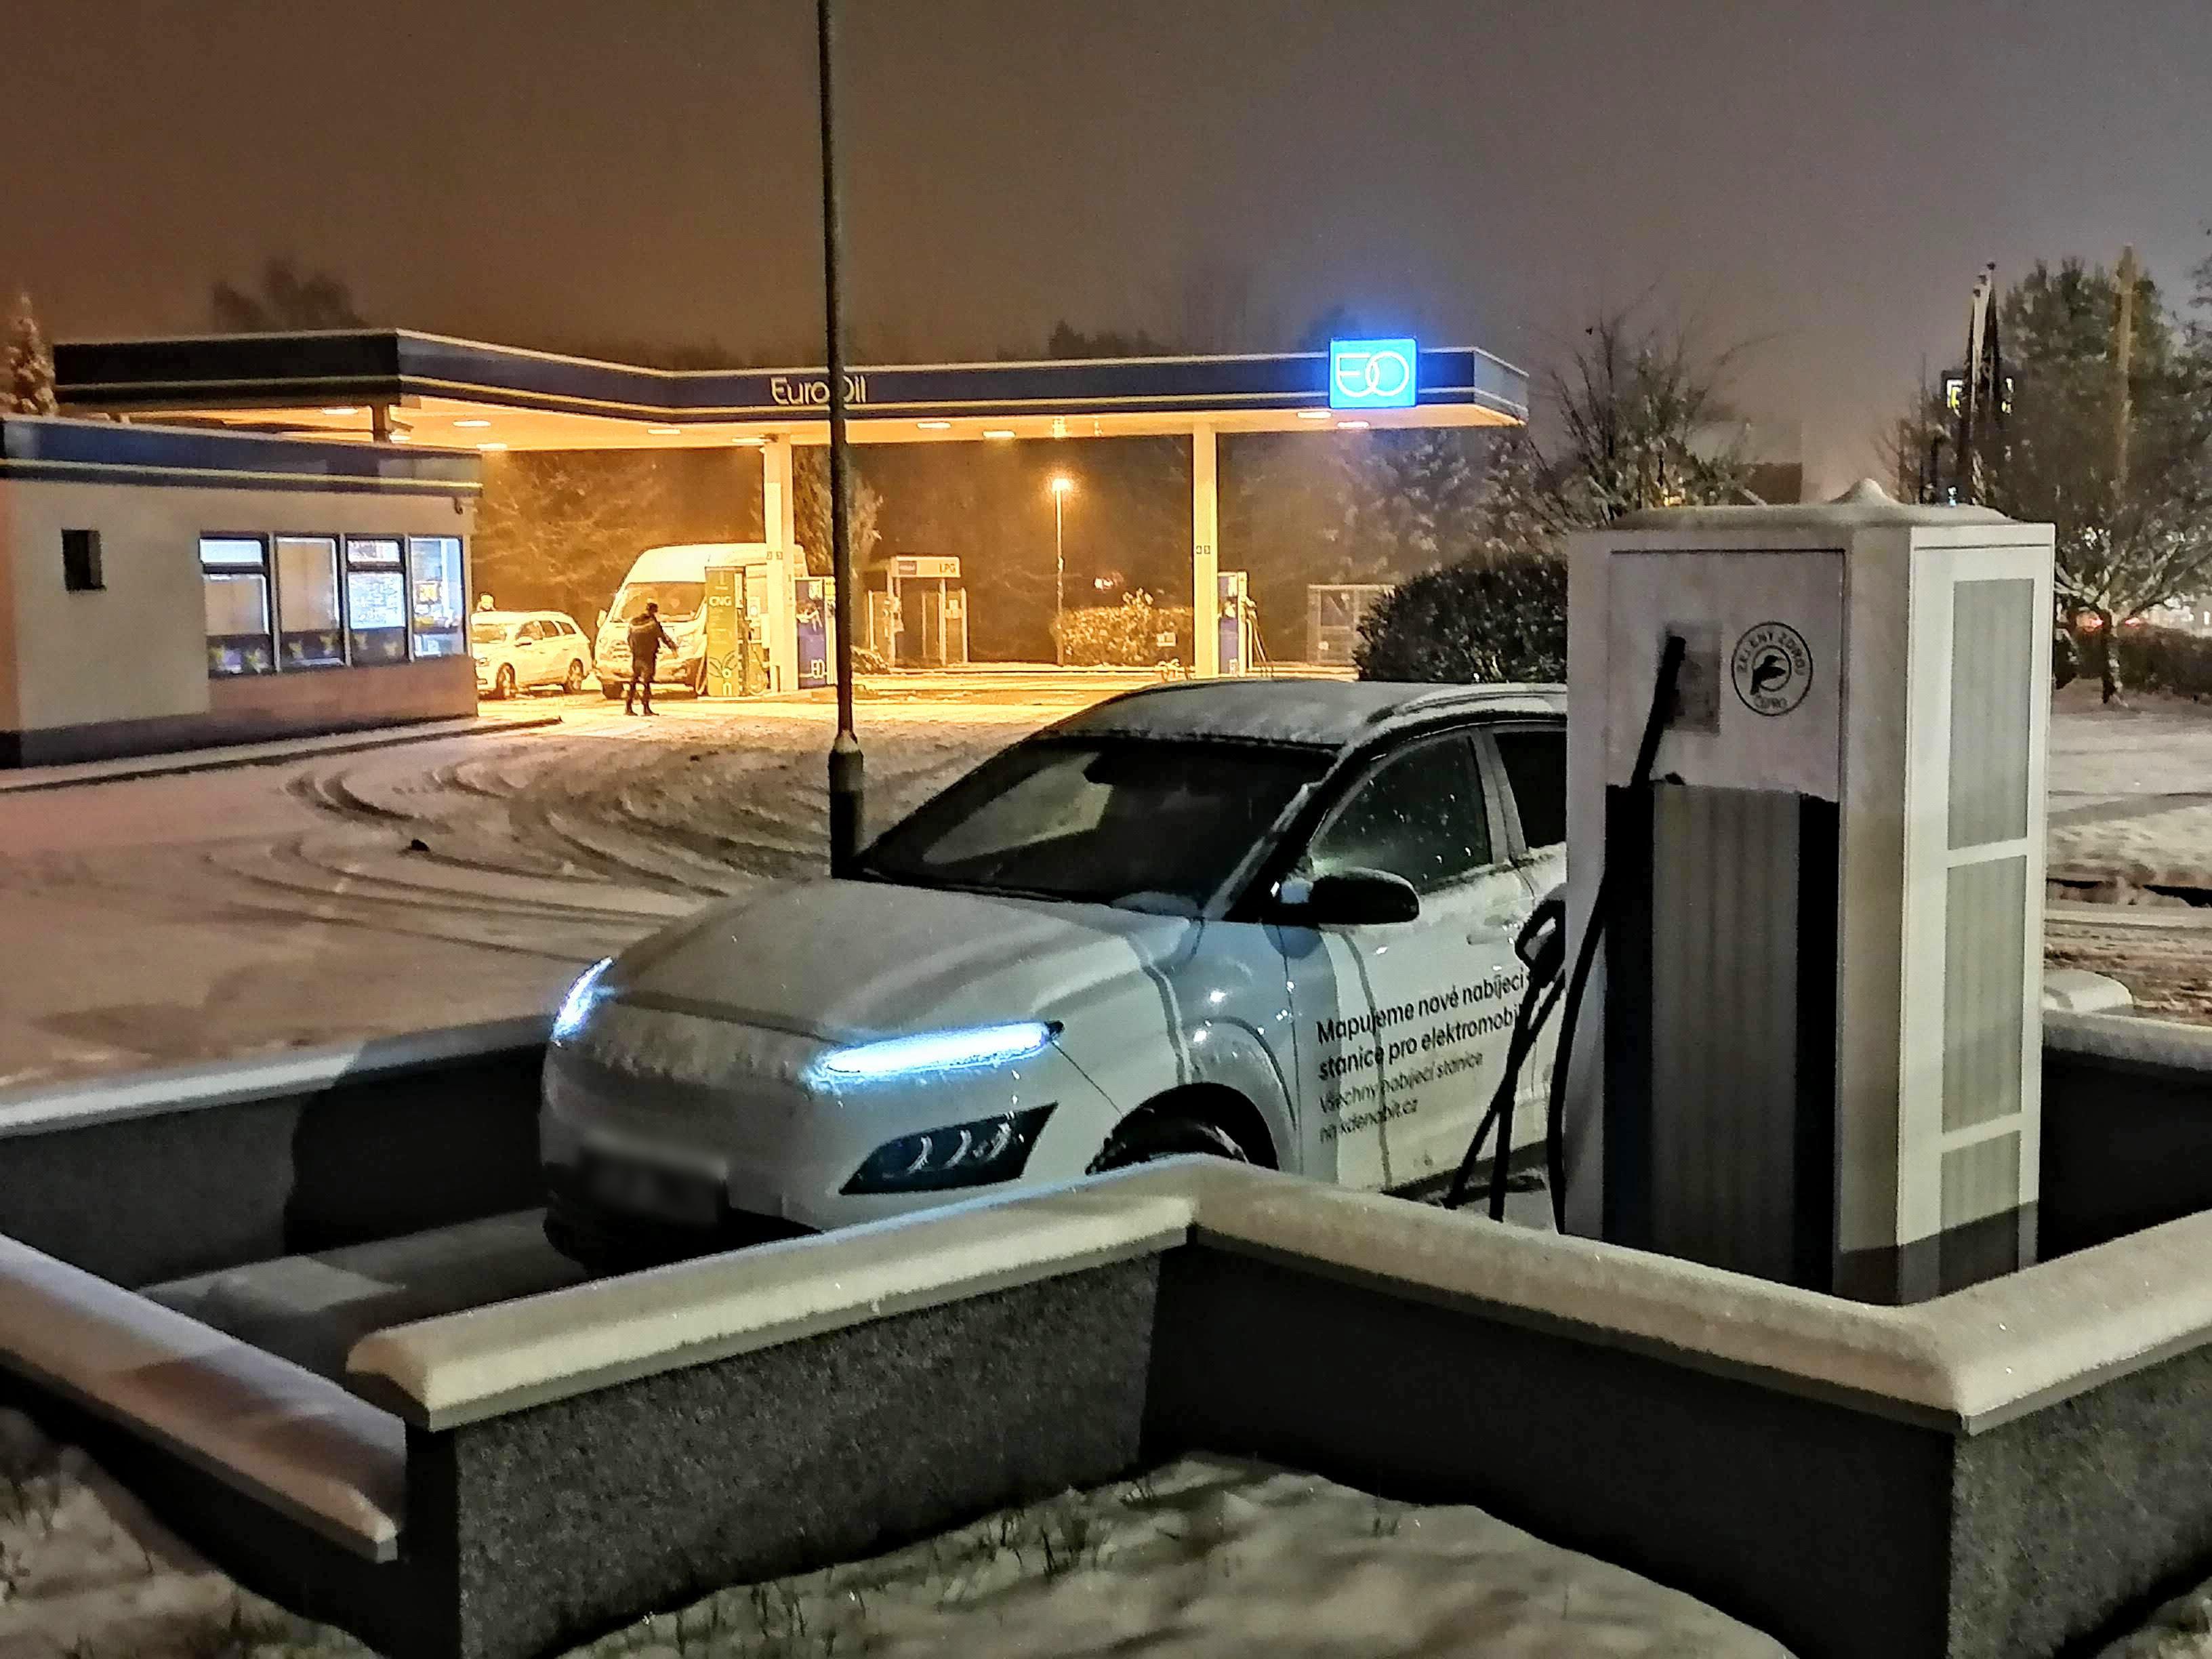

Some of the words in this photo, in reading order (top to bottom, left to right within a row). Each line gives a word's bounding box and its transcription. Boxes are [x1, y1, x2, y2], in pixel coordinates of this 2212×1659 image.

[939, 563, 956, 573] LPG
[1316, 1002, 1414, 1044] Mapujeme
[1418, 985, 1458, 1017] nové
[1317, 1046, 1384, 1081] stanice
[1389, 1036, 1418, 1065] pro
[1422, 1003, 1521, 1051] elektromobi
